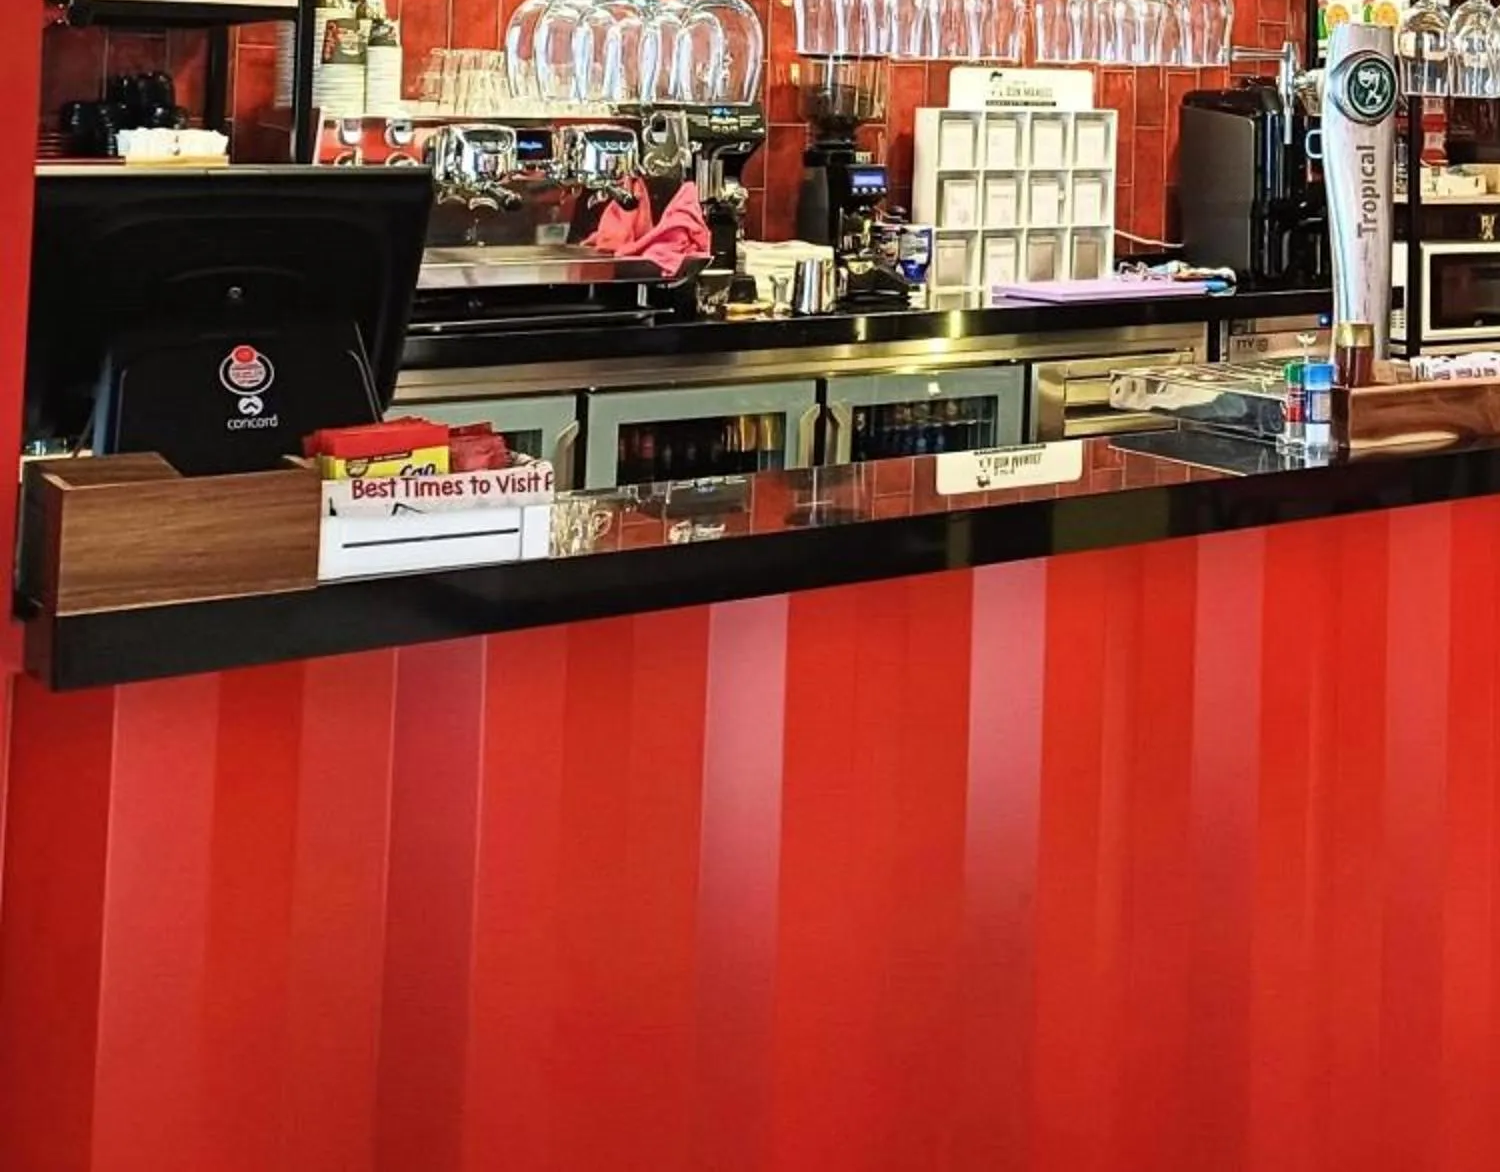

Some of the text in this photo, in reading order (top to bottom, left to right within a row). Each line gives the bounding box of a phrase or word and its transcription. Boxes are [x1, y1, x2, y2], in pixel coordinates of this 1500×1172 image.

[1356, 145, 1381, 239] Tropical
[351, 479, 396, 500] Best
[399, 476, 463, 498] Times
[471, 478, 492, 496] to
[495, 471, 542, 494] Visit
